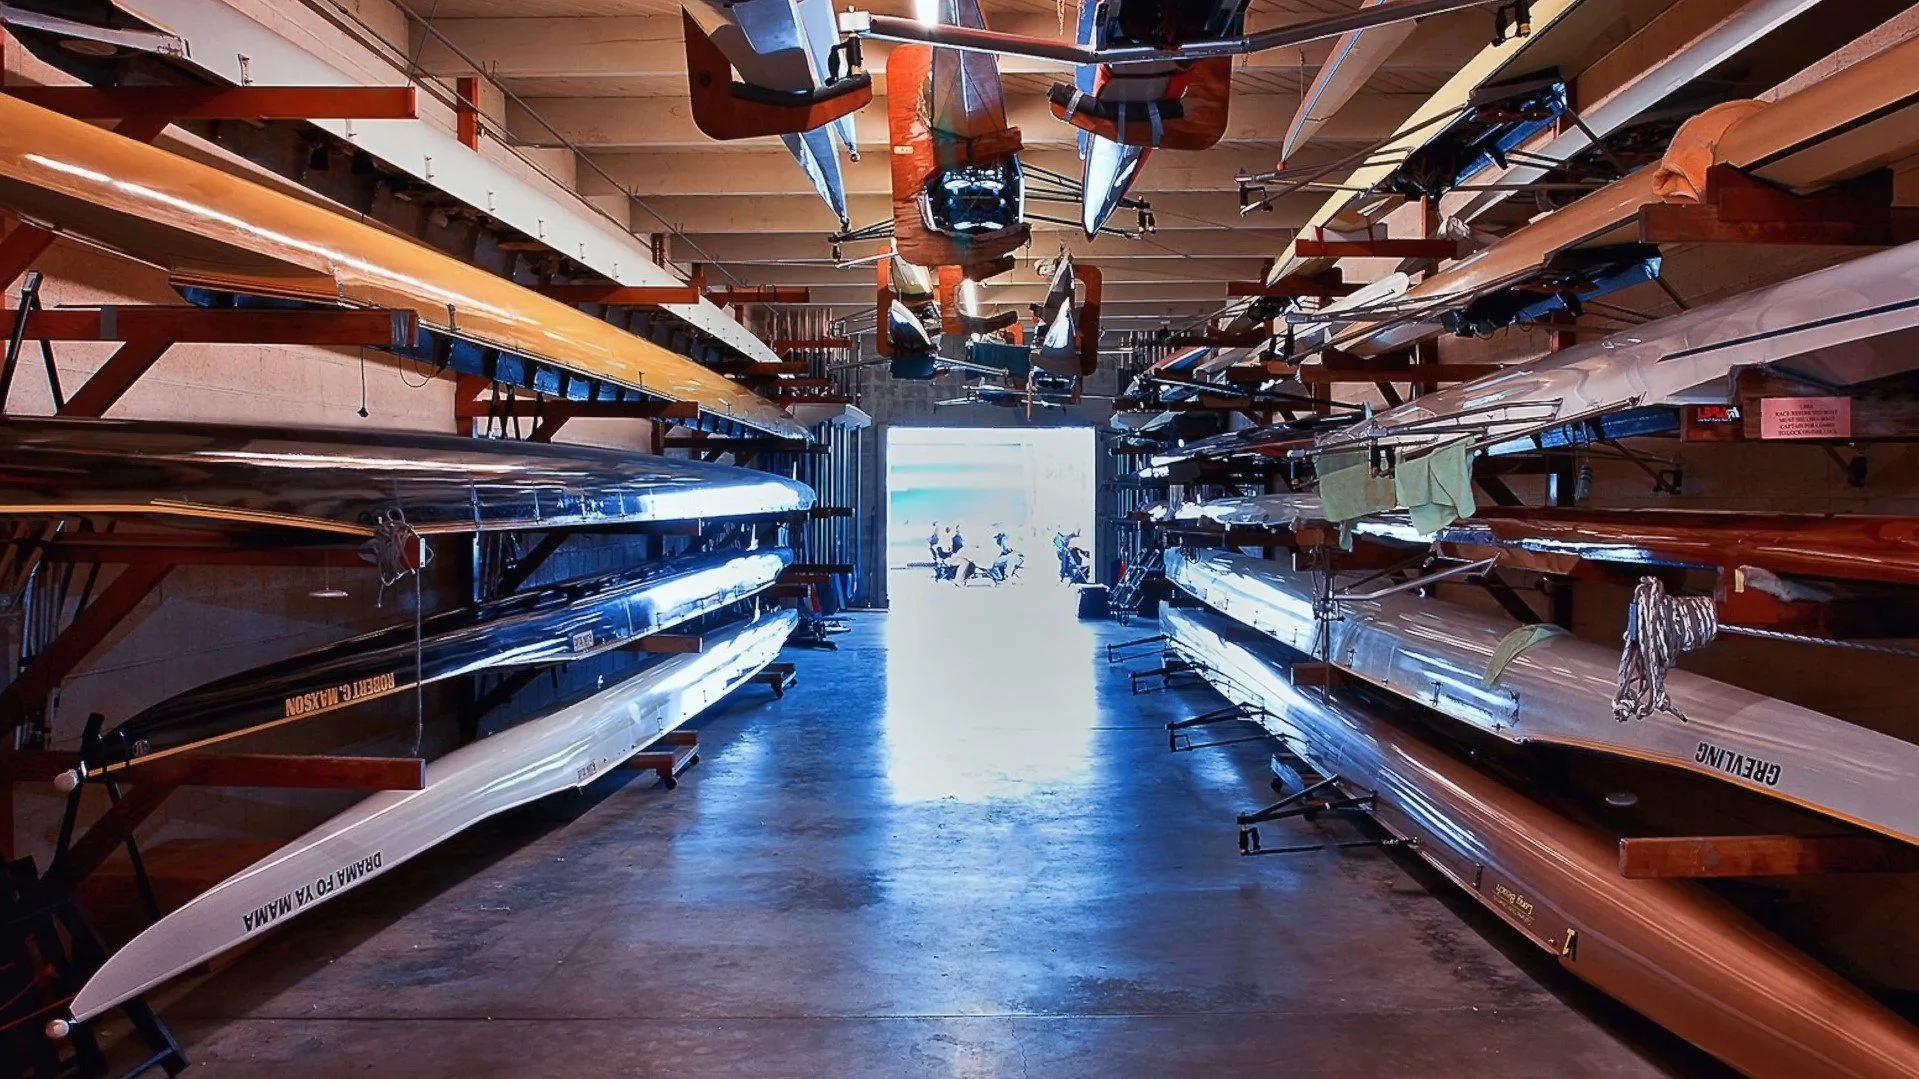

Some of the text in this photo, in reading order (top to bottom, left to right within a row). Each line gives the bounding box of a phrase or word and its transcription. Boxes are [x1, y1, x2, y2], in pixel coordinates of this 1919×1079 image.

[285, 672, 395, 717] ROBERT C. MAXSON
[1695, 742, 1782, 787] GREVLING
[242, 851, 383, 932] DRAMA FO YA MAMA
[1516, 894, 1534, 915] Long
